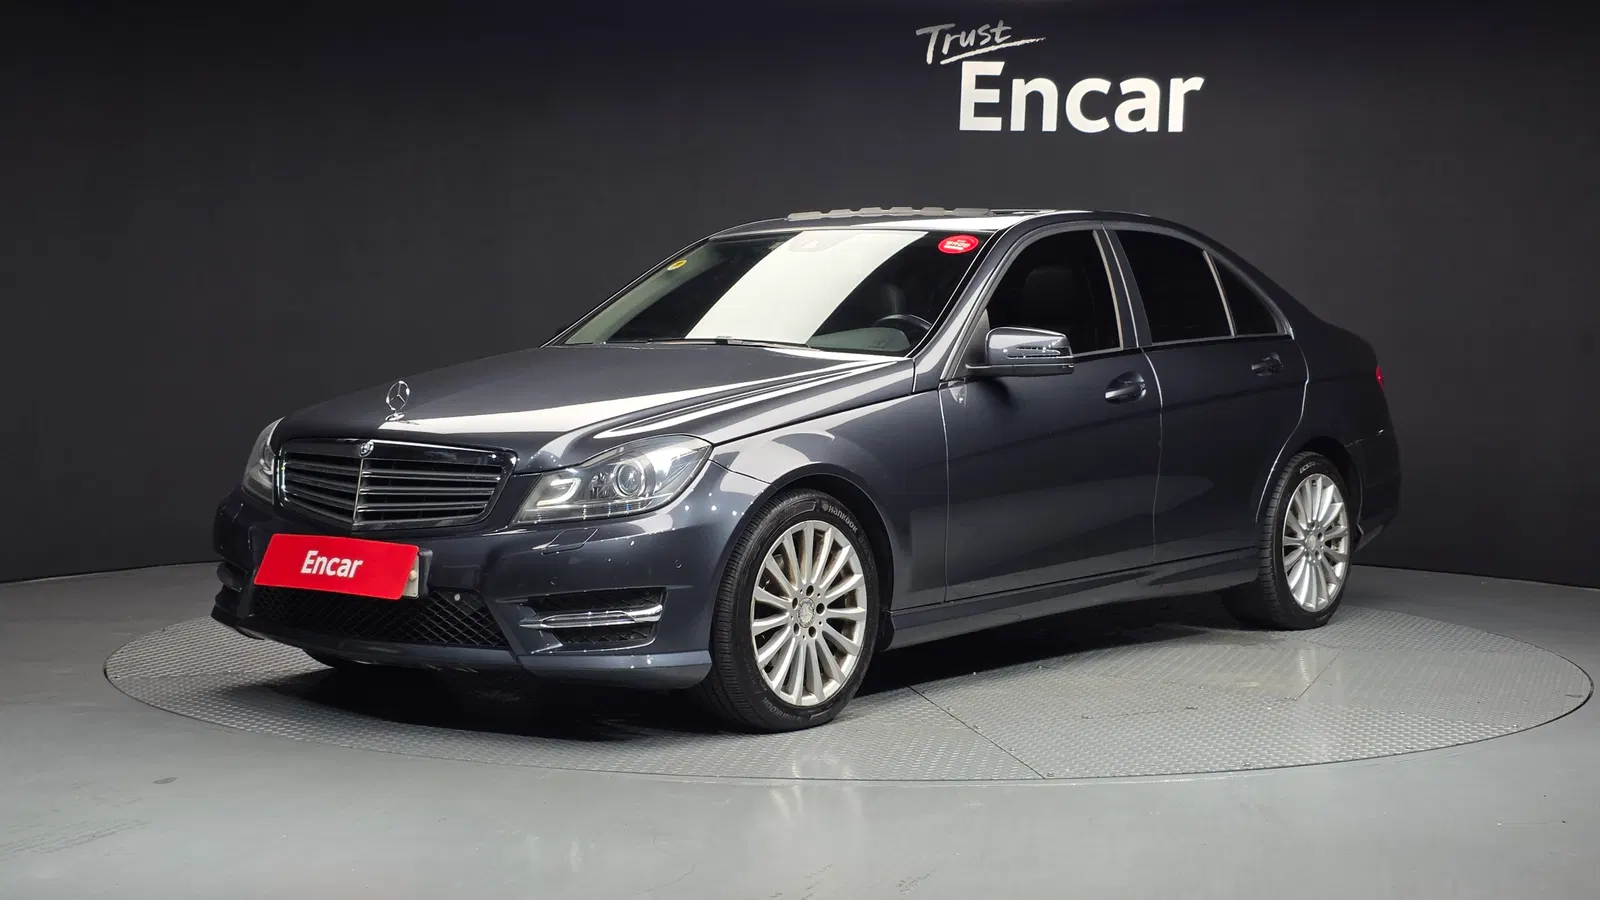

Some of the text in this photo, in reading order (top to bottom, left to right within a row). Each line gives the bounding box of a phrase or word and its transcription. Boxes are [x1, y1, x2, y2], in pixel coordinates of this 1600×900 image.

[916, 20, 1012, 65] Trust
[959, 61, 1205, 133] Encar
[300, 550, 364, 578] Encar
